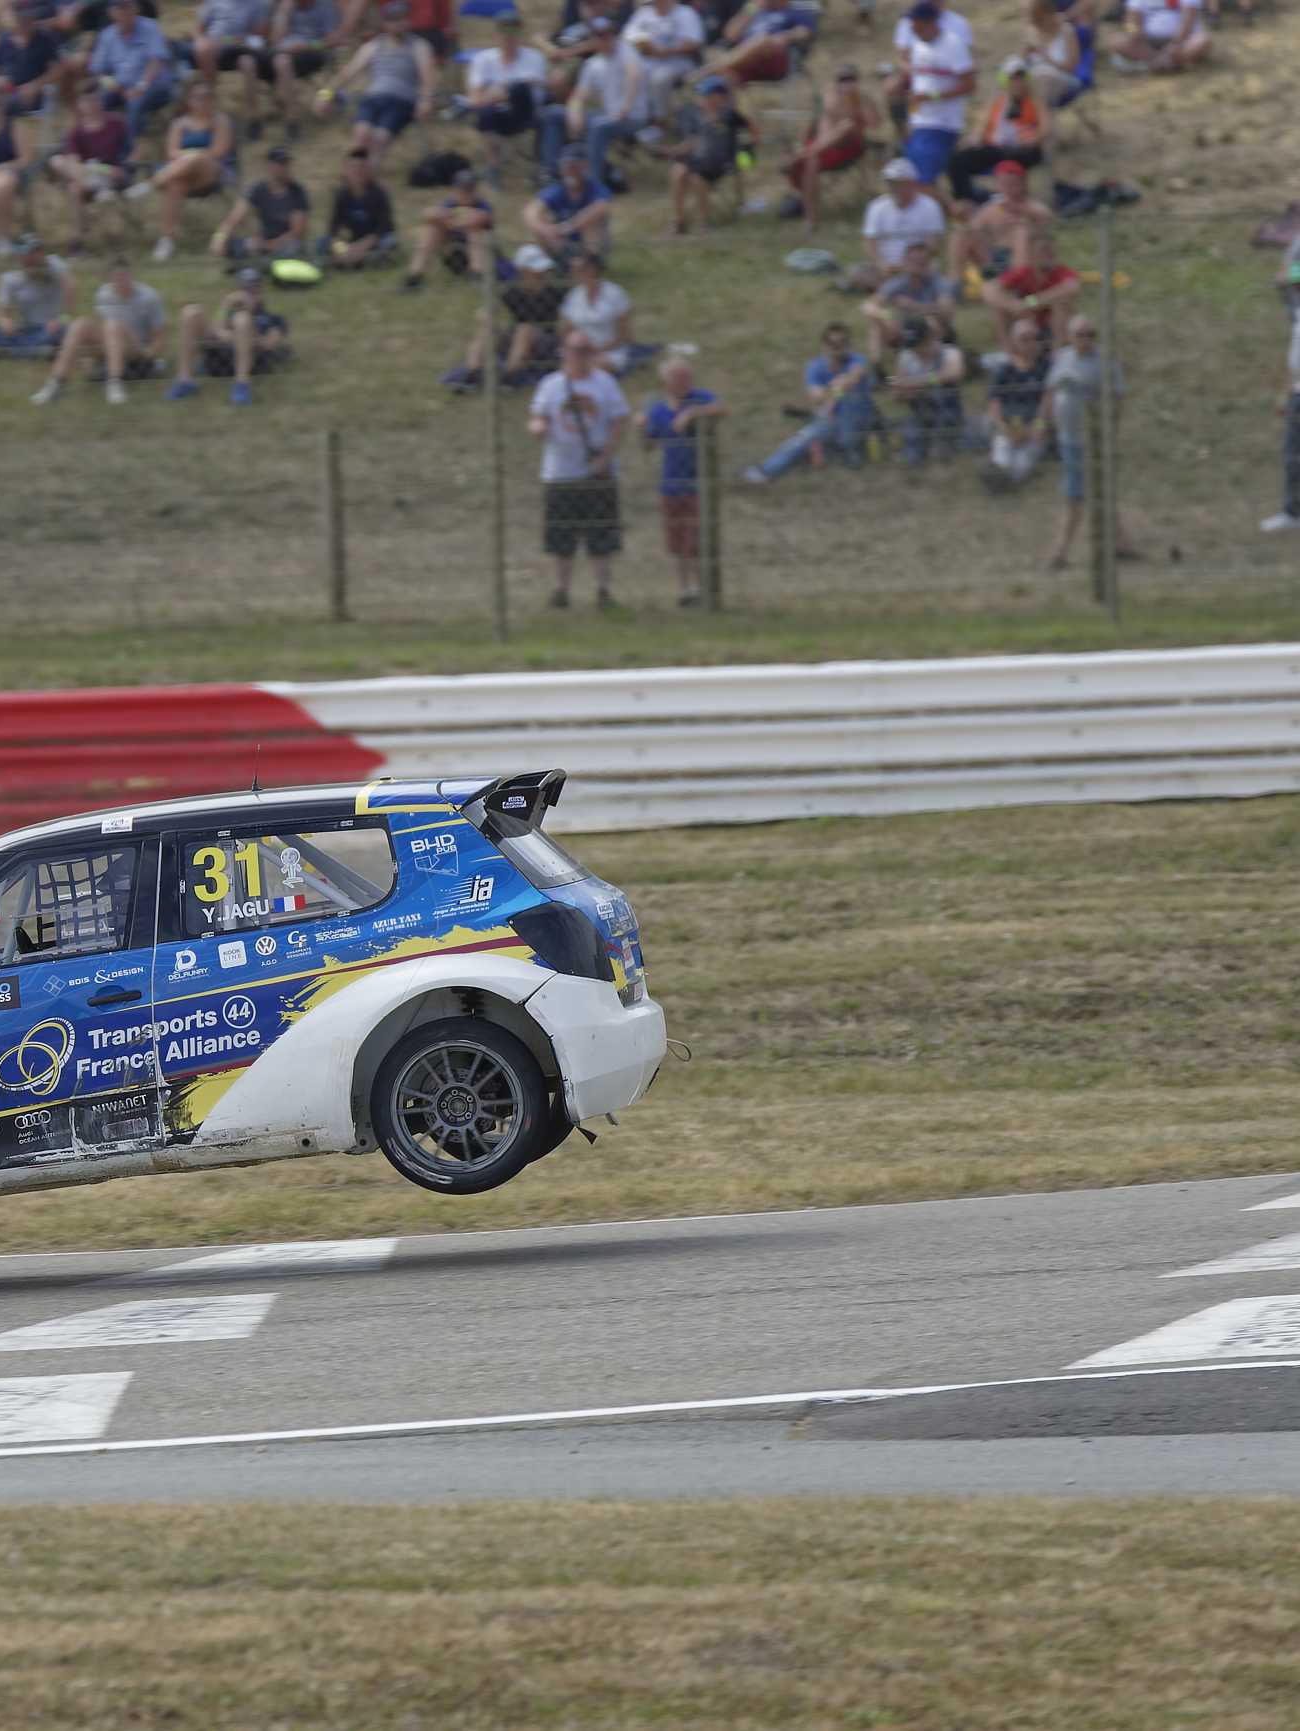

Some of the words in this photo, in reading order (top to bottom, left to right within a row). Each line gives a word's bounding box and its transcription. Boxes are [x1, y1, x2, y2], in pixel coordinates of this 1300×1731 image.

[410, 834, 455, 853] BHD
[436, 845, 457, 854] PUB
[192, 842, 262, 902] 31
[372, 918, 397, 930] AZUR
[399, 913, 422, 924] TAXI
[68, 976, 90, 986] BOIS
[111, 966, 144, 979] DESIGN
[168, 967, 209, 982] DELAUNAY
[88, 1009, 218, 1050] Transports
[227, 1003, 251, 1021] 44
[76, 1050, 156, 1079] France
[166, 1028, 261, 1063] Alliance
[17, 1131, 34, 1139] Audi
